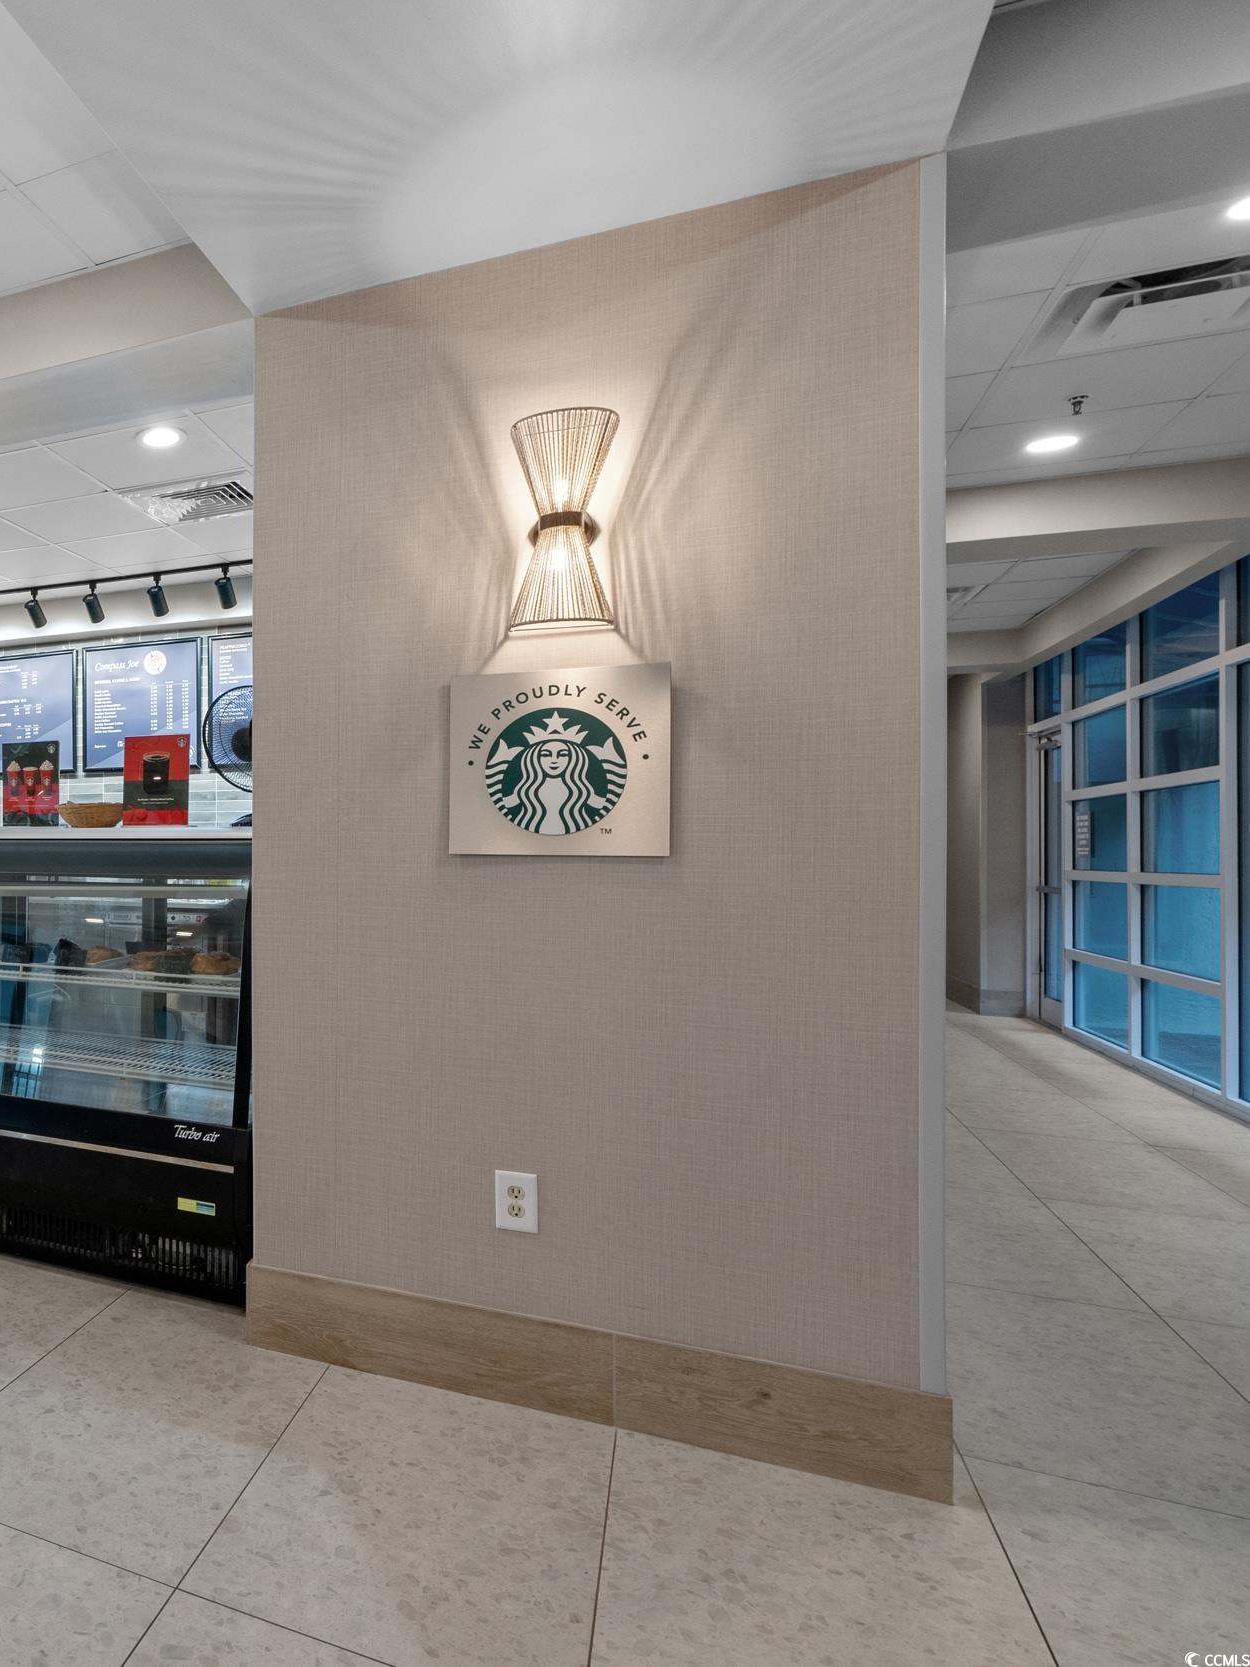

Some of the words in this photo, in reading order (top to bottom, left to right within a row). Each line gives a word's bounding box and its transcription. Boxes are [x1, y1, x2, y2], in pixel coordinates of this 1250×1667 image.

[94, 662, 126, 673] Compass
[126, 659, 140, 670] Joe
[468, 723, 492, 751] WE
[491, 684, 587, 719] PROUDLY
[594, 692, 648, 743] SERVE
[174, 1124, 202, 1140] Turbo
[203, 1131, 220, 1143] air
